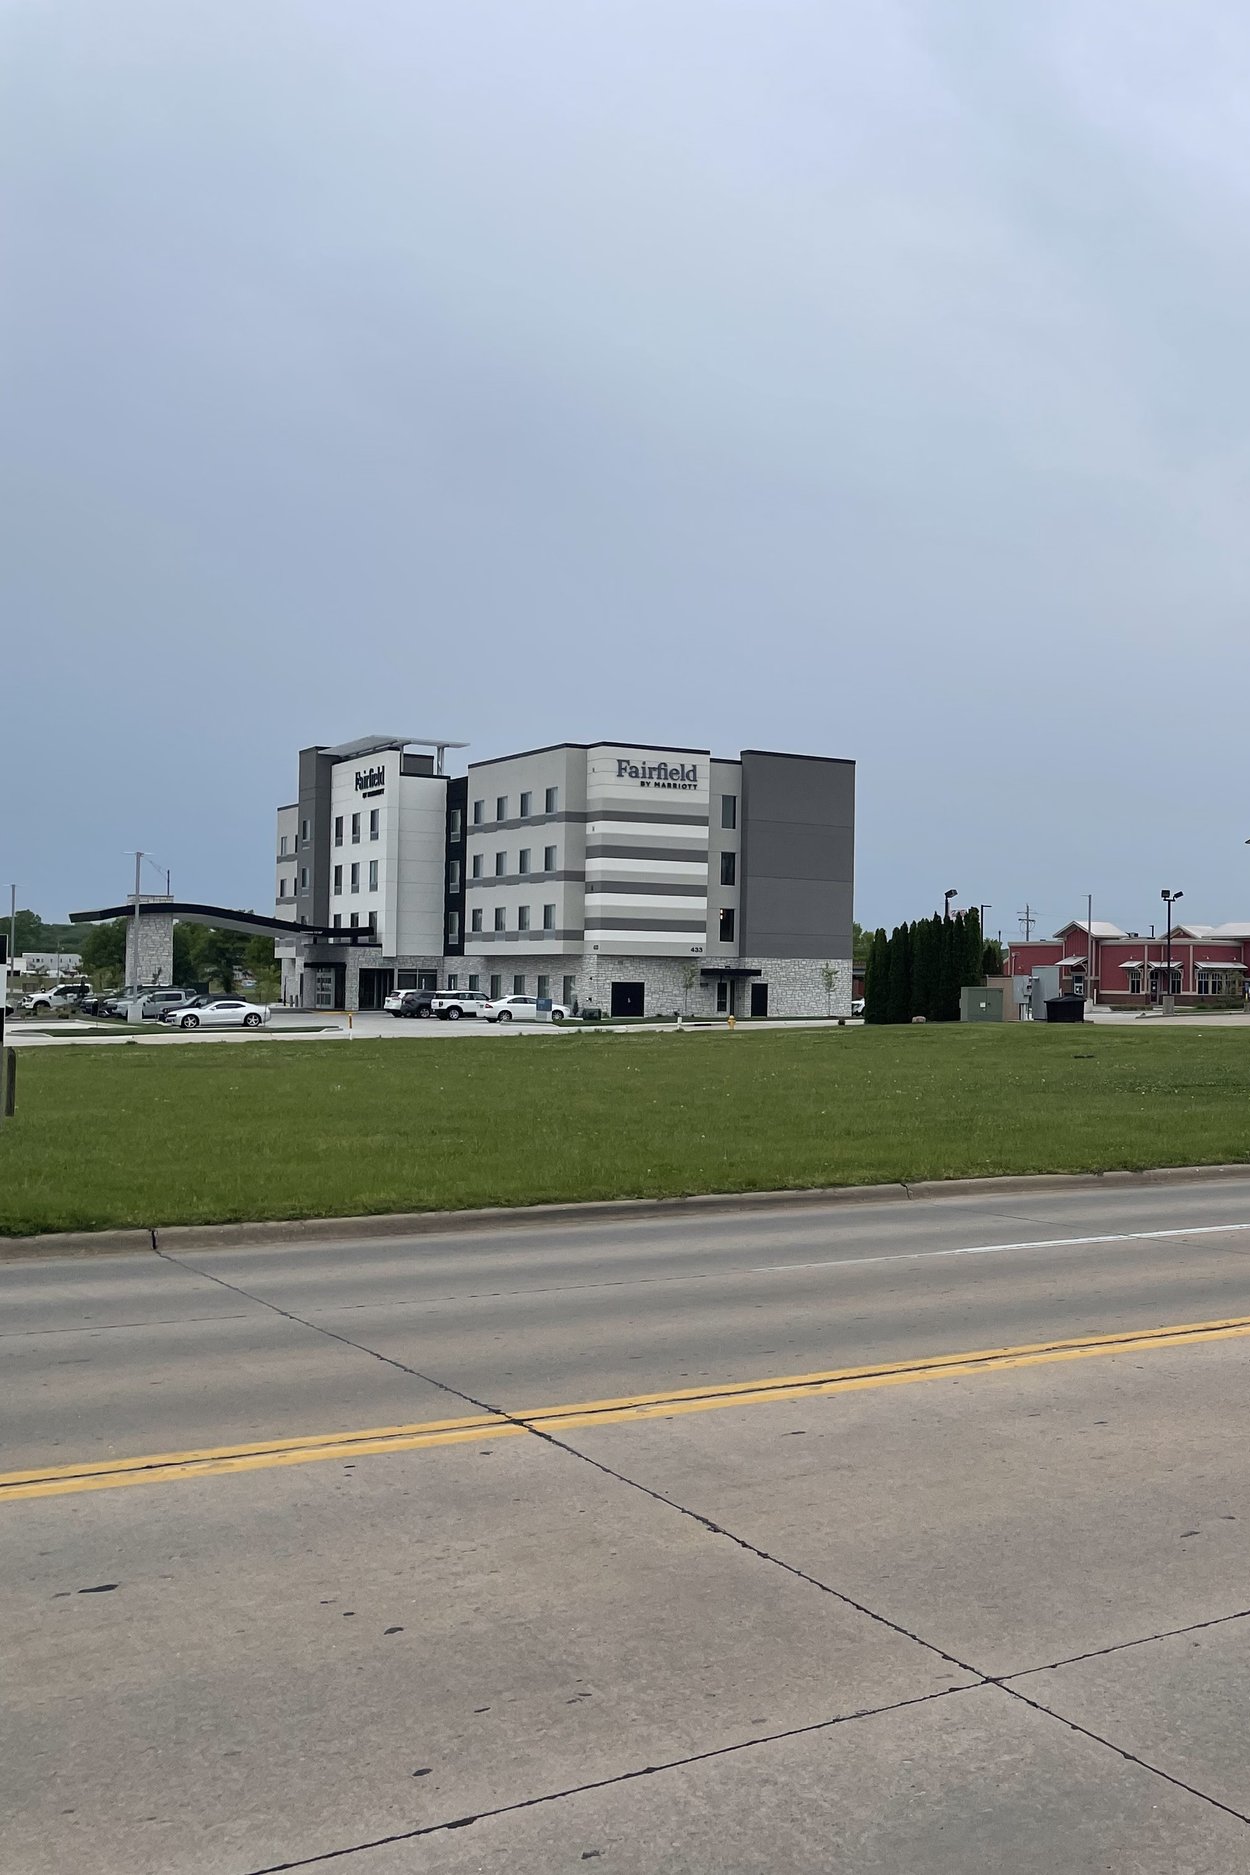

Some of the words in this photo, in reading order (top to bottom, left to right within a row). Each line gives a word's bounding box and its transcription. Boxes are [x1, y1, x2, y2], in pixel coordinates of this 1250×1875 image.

[355, 765, 385, 791] Fairfield
[616, 759, 698, 782] Fairfield
[640, 780, 651, 788] BY
[654, 781, 698, 790] MARRIOTT
